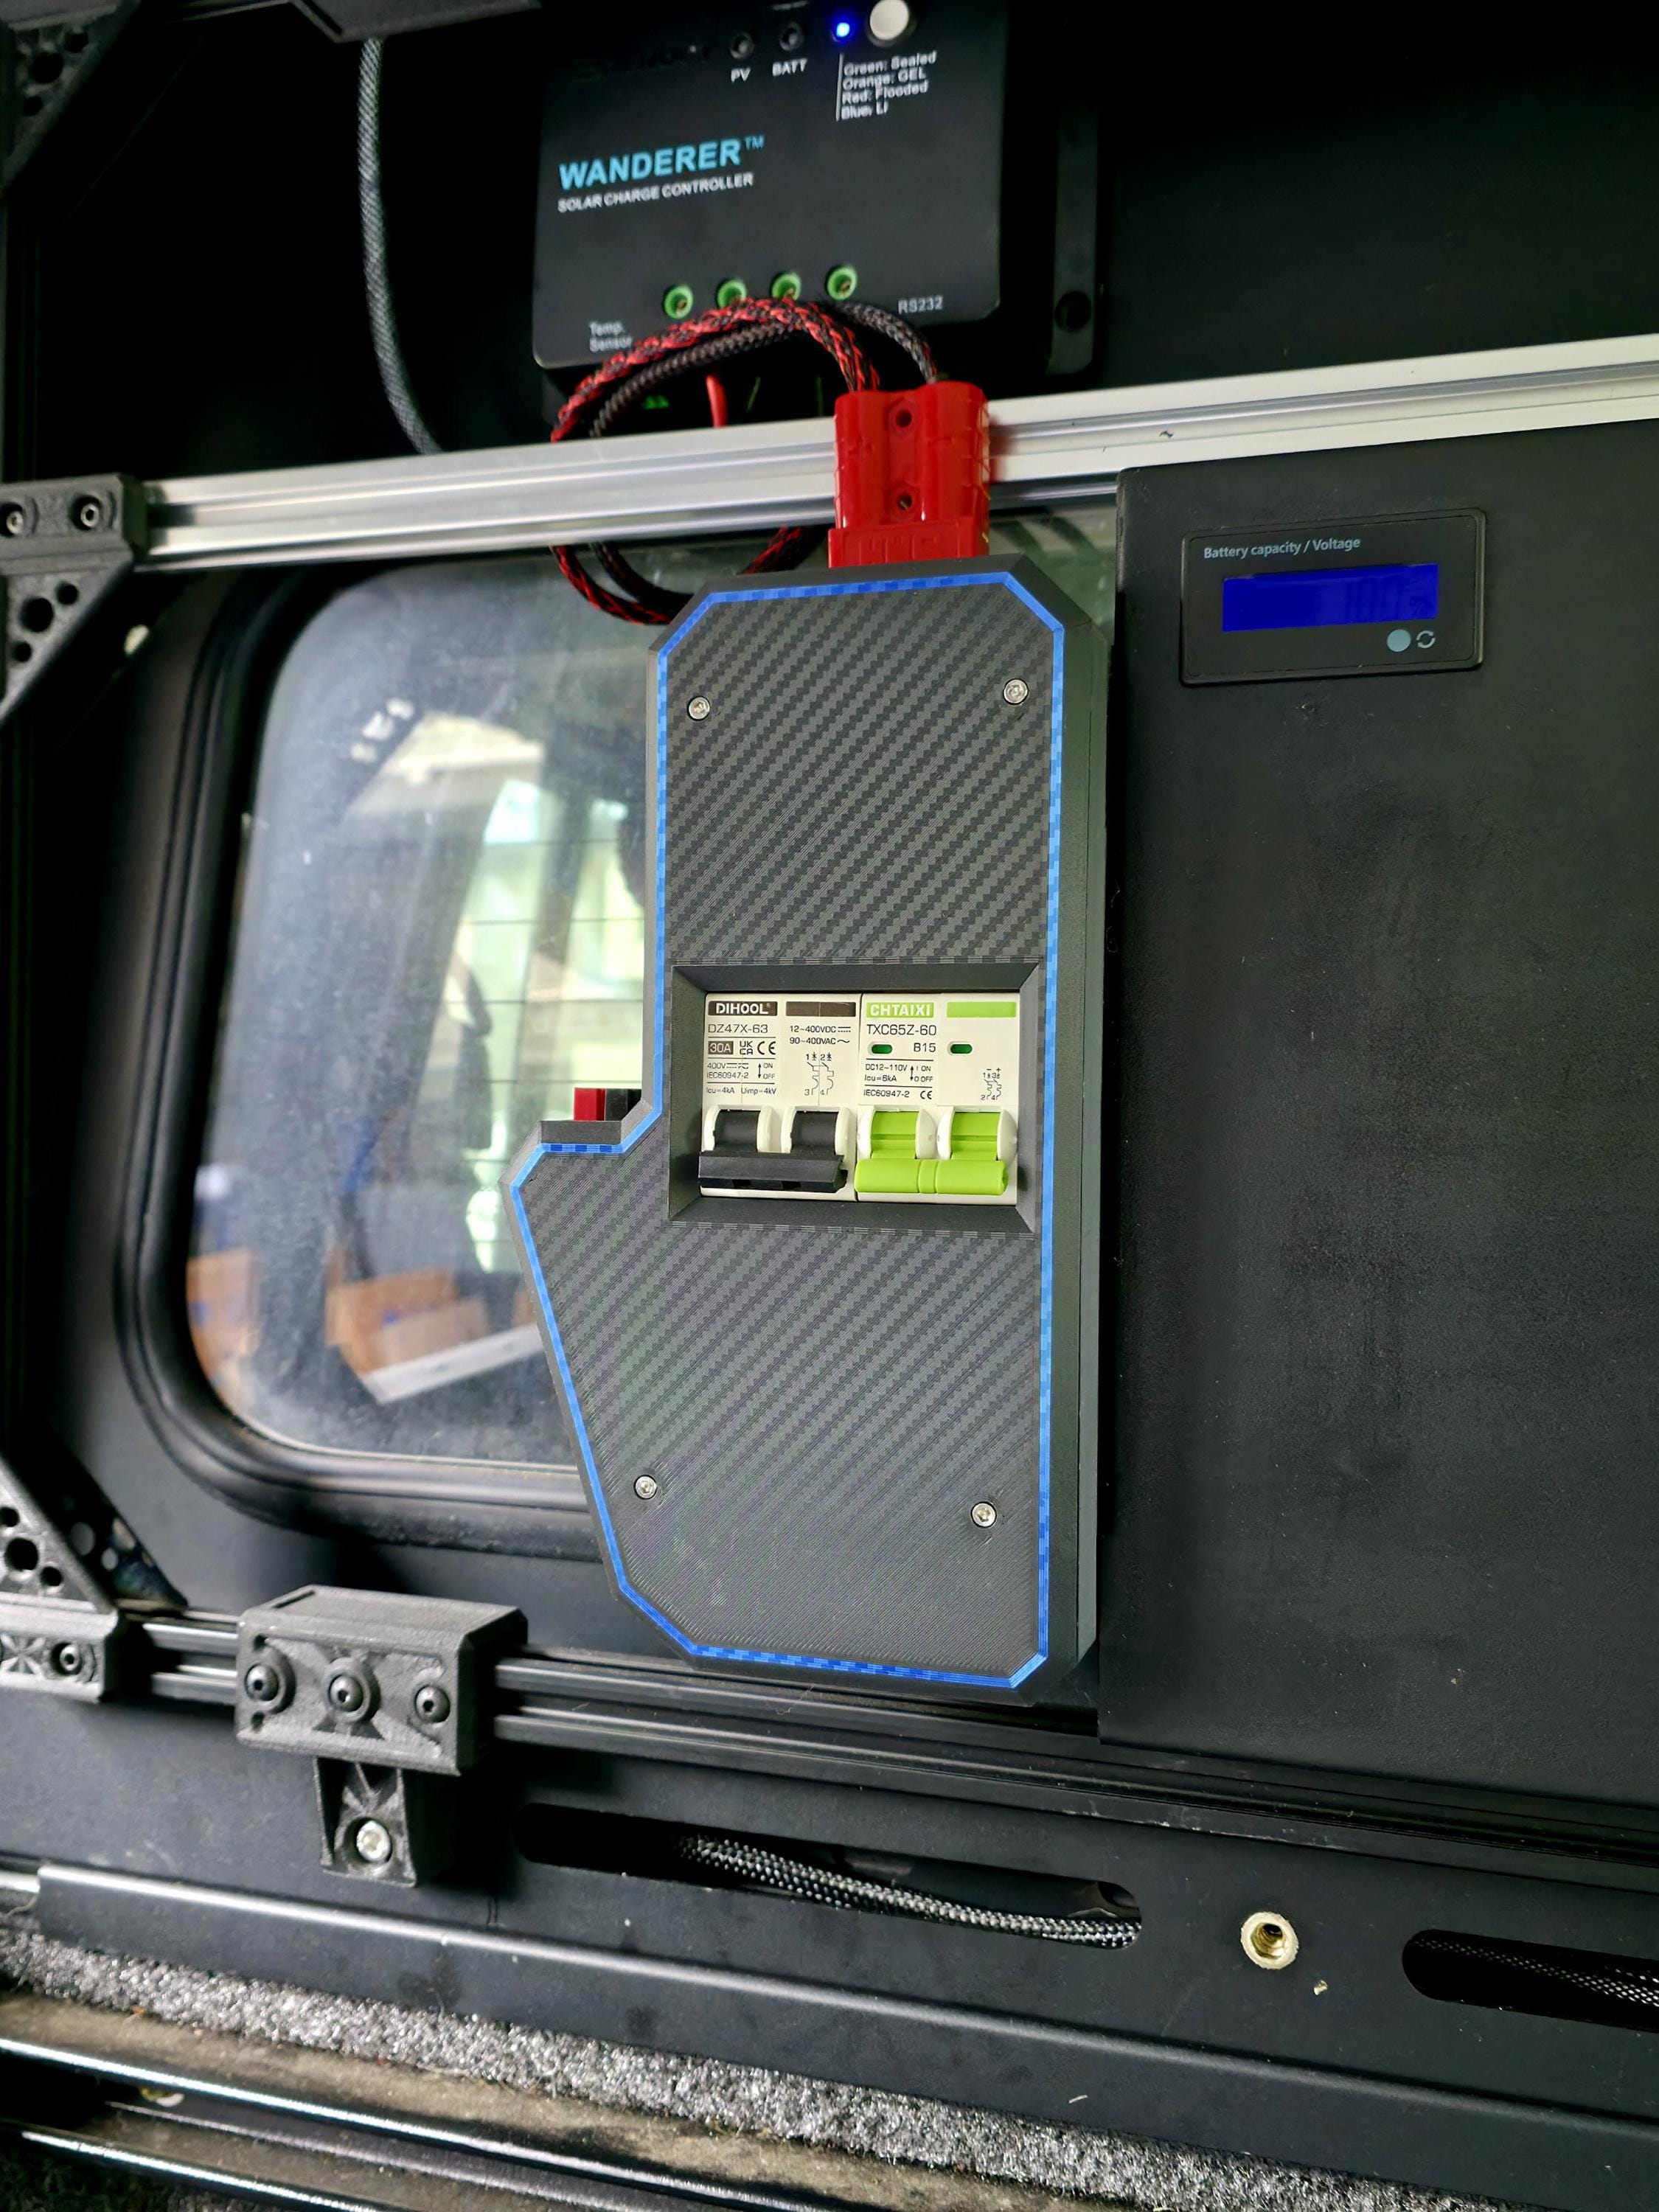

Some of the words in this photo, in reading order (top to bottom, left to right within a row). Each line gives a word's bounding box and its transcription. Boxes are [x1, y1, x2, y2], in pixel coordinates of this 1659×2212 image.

[772, 58, 807, 77] BATT
[844, 60, 887, 77] Green:
[891, 50, 937, 70] Sealed
[731, 67, 751, 83] PV
[842, 72, 895, 91] Orange:
[897, 68, 927, 82] GEL
[841, 91, 872, 105] Red:
[875, 80, 930, 100] Flooded
[557, 192, 602, 213] SOLAR
[604, 186, 661, 206] CHARGE
[662, 172, 754, 197] CONTROLLER
[898, 296, 943, 315] RS232
[589, 336, 633, 352] Sensor
[1203, 547, 1248, 560] Battery
[1251, 541, 1302, 557] capacity
[1303, 540, 1310, 553] /
[1312, 537, 1361, 552] Voltage
[870, 1004, 931, 1016] CHTAIXI
[708, 1023, 768, 1034] DZ47X-63
[866, 1024, 936, 1036] TXC65Z-60
[709, 1043, 731, 1053] 30A
[914, 1043, 936, 1052] B15
[865, 1063, 908, 1071] DC12~110V
[863, 1089, 910, 1097] IEC60947-2
